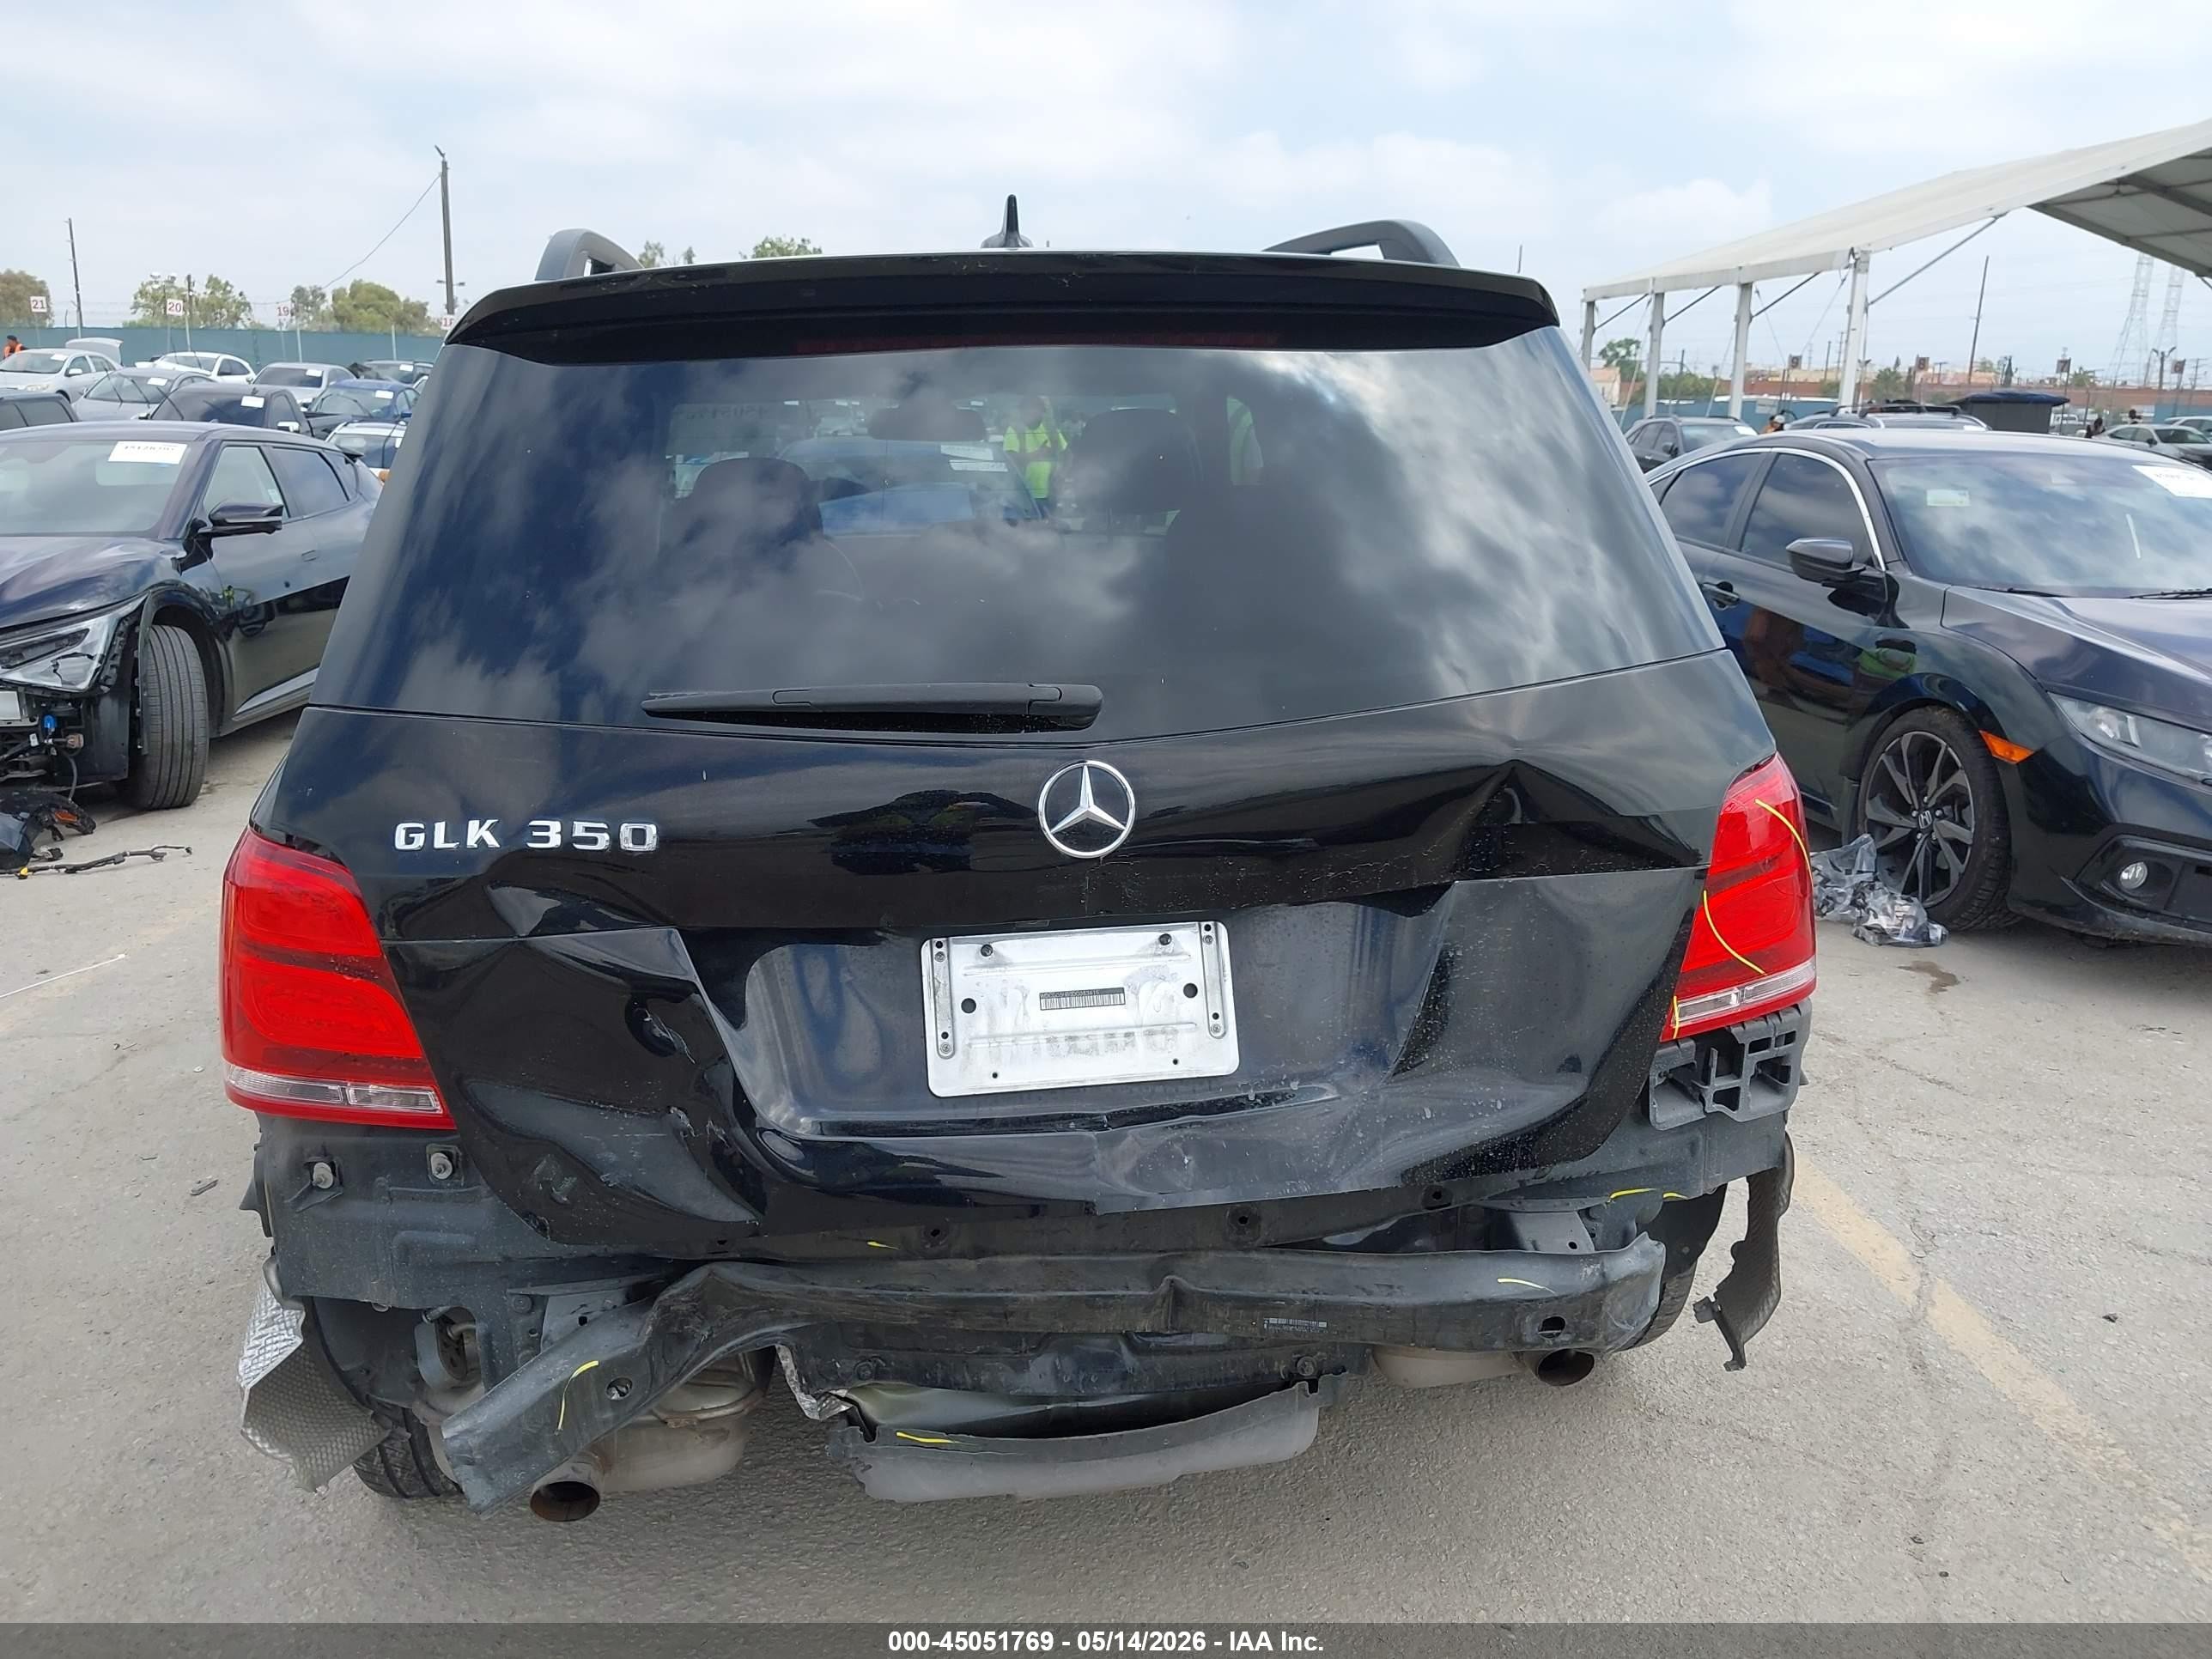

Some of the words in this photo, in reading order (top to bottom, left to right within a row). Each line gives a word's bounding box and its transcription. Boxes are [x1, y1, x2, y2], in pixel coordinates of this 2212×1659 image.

[32, 299, 46, 309] 21
[167, 301, 182, 313] 20
[277, 306, 289, 316] 19
[395, 819, 501, 850] GLK
[526, 820, 658, 852] 350
